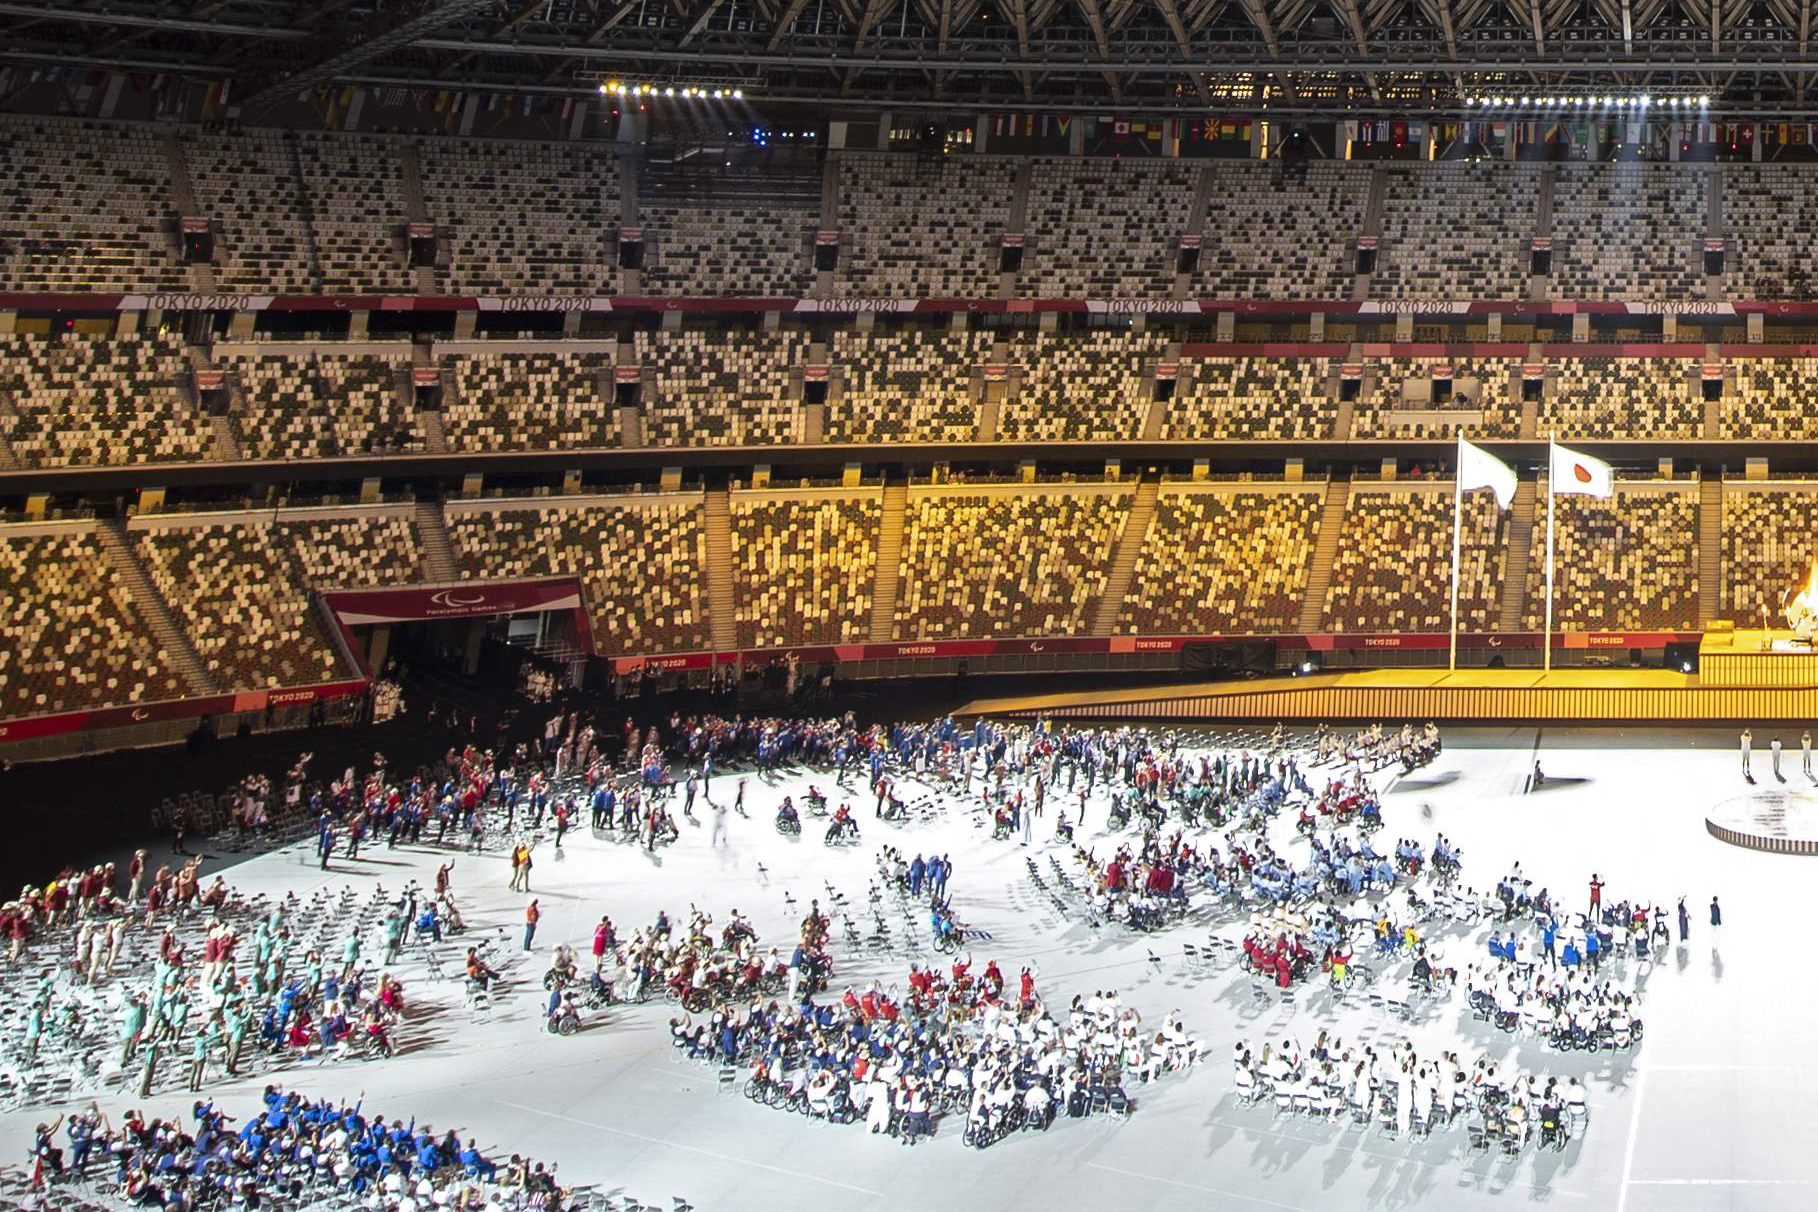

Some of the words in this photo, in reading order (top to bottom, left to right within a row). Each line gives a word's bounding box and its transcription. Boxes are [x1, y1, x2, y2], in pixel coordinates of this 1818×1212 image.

[145, 295, 201, 310] TOKYO
[209, 295, 249, 310] 2020
[500, 297, 550, 310] TOKYO
[554, 297, 592, 310] 2020
[816, 298, 861, 311] TOKYO
[865, 298, 898, 311] 2020
[1105, 299, 1147, 312] TOKYO
[1151, 299, 1184, 312] 2020
[1378, 300, 1419, 313] TOKYO
[1422, 300, 1453, 313] 2020
[1643, 301, 1683, 314] TOKYO
[1687, 301, 1718, 314] 2020
[471, 604, 497, 612] Games
[1136, 641, 1156, 649] TOKYO
[1365, 638, 1384, 646] TOKYO
[1589, 637, 1608, 645] TOKYO
[898, 647, 921, 655] TOKYO
